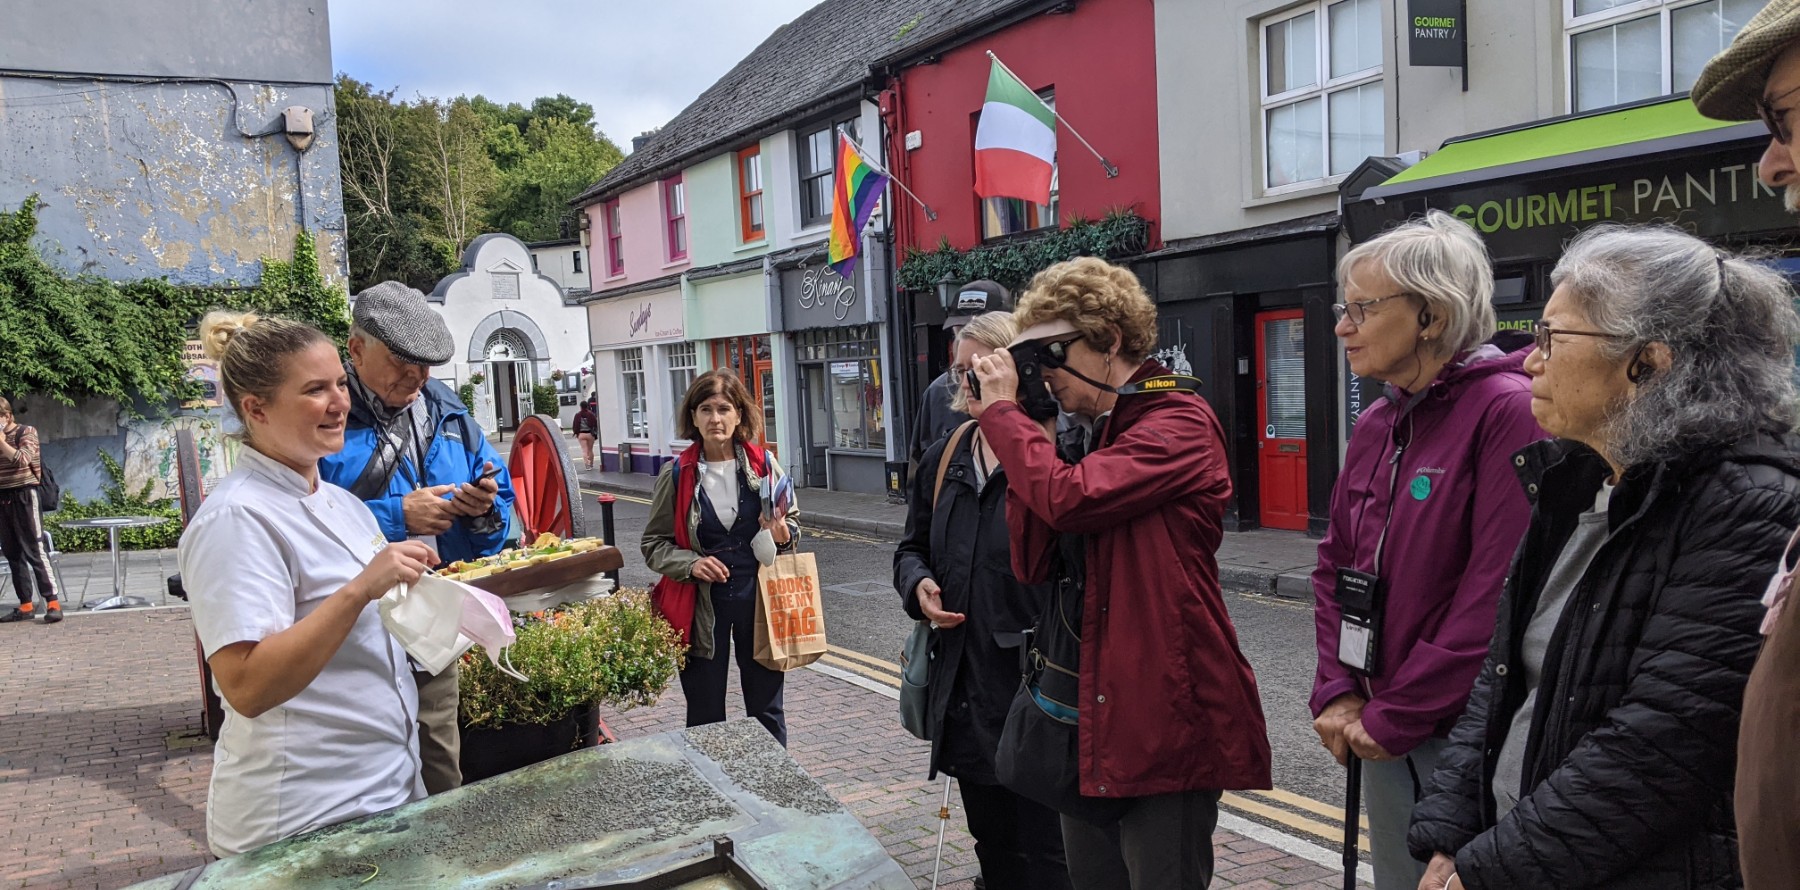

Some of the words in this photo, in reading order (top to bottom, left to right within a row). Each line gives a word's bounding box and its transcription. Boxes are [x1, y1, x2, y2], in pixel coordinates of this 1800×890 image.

[1414, 16, 1455, 28] GOURMET
[1415, 28, 1449, 38] PANTRY
[1634, 162, 1776, 214] PANTR
[1145, 379, 1176, 389] Nikon
[1350, 371, 1361, 417] ANTRY
[766, 575, 813, 596] BOOKS
[770, 594, 795, 612] ARE
[795, 592, 813, 608] MY
[771, 606, 817, 640] BAG
